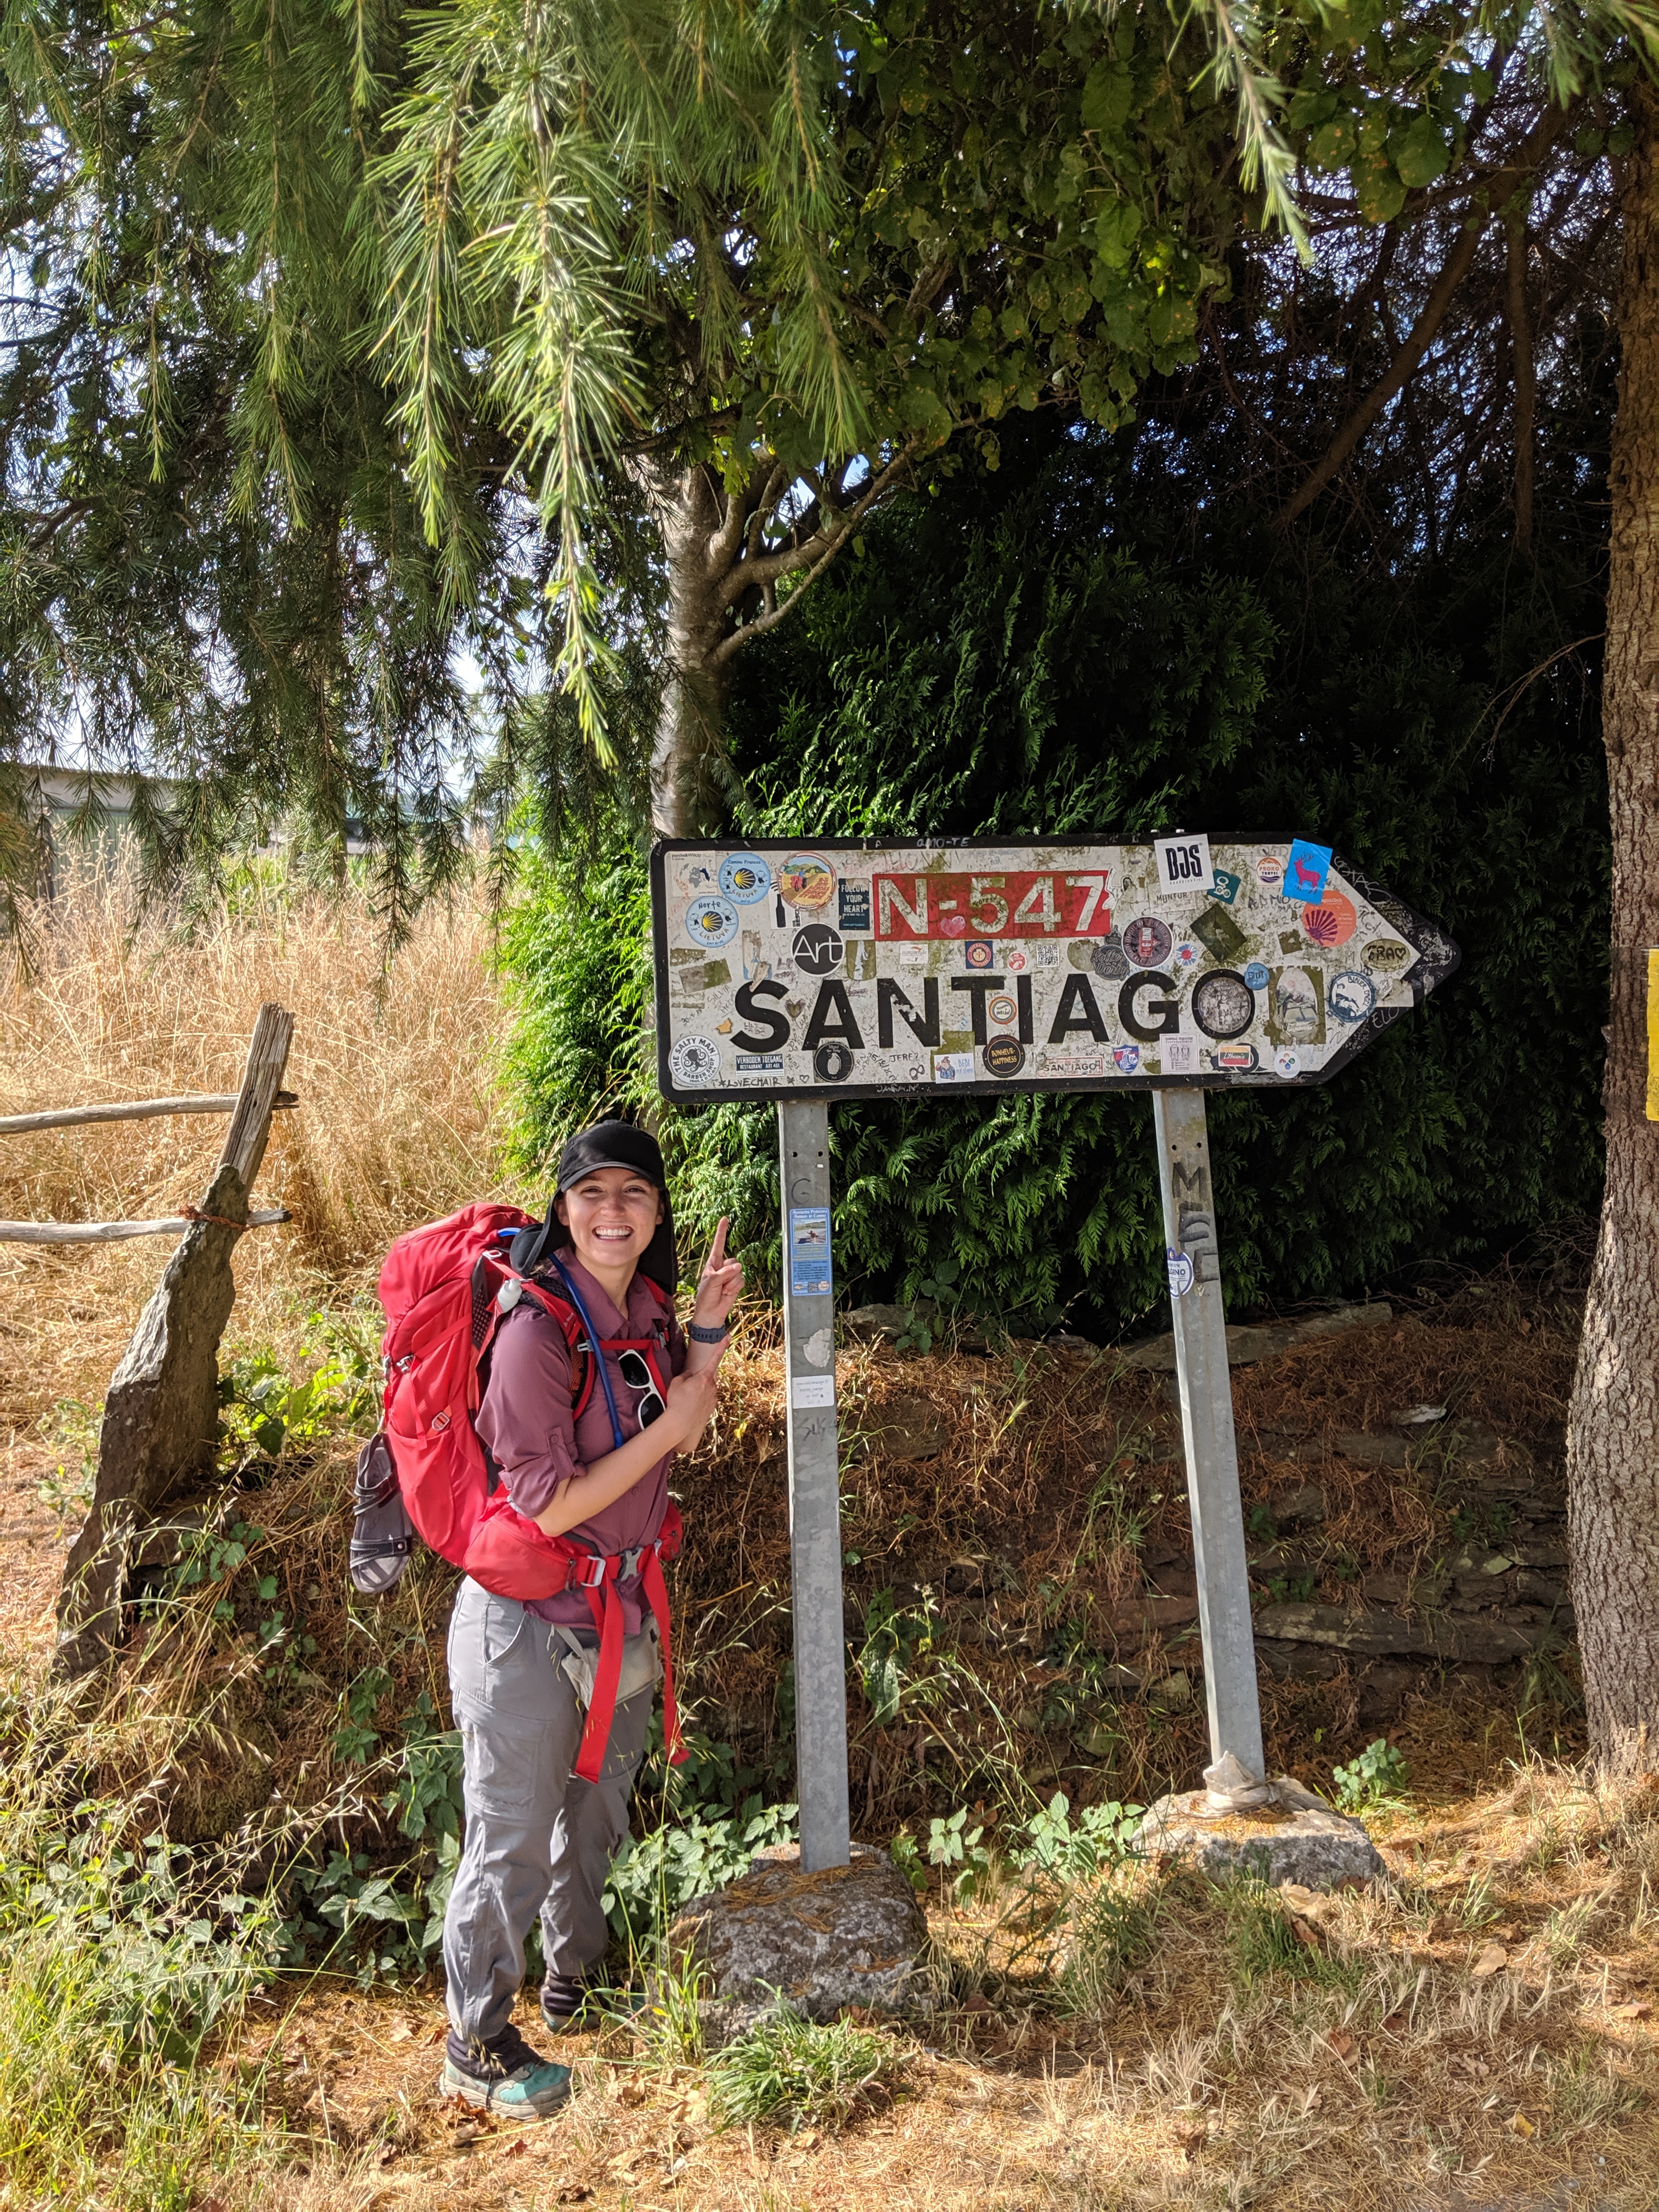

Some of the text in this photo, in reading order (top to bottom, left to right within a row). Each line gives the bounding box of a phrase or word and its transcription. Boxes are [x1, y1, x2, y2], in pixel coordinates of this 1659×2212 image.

[698, 900, 721, 910] Norte
[843, 905, 864, 913] HEART
[845, 894, 863, 903] YOUR
[878, 876, 1104, 935] N-547
[793, 935, 843, 963] Art
[730, 969, 1255, 1053] SANTIAGO
[673, 1037, 715, 1072] THE SALTY MAN
[706, 1058, 714, 1073] SHOP
